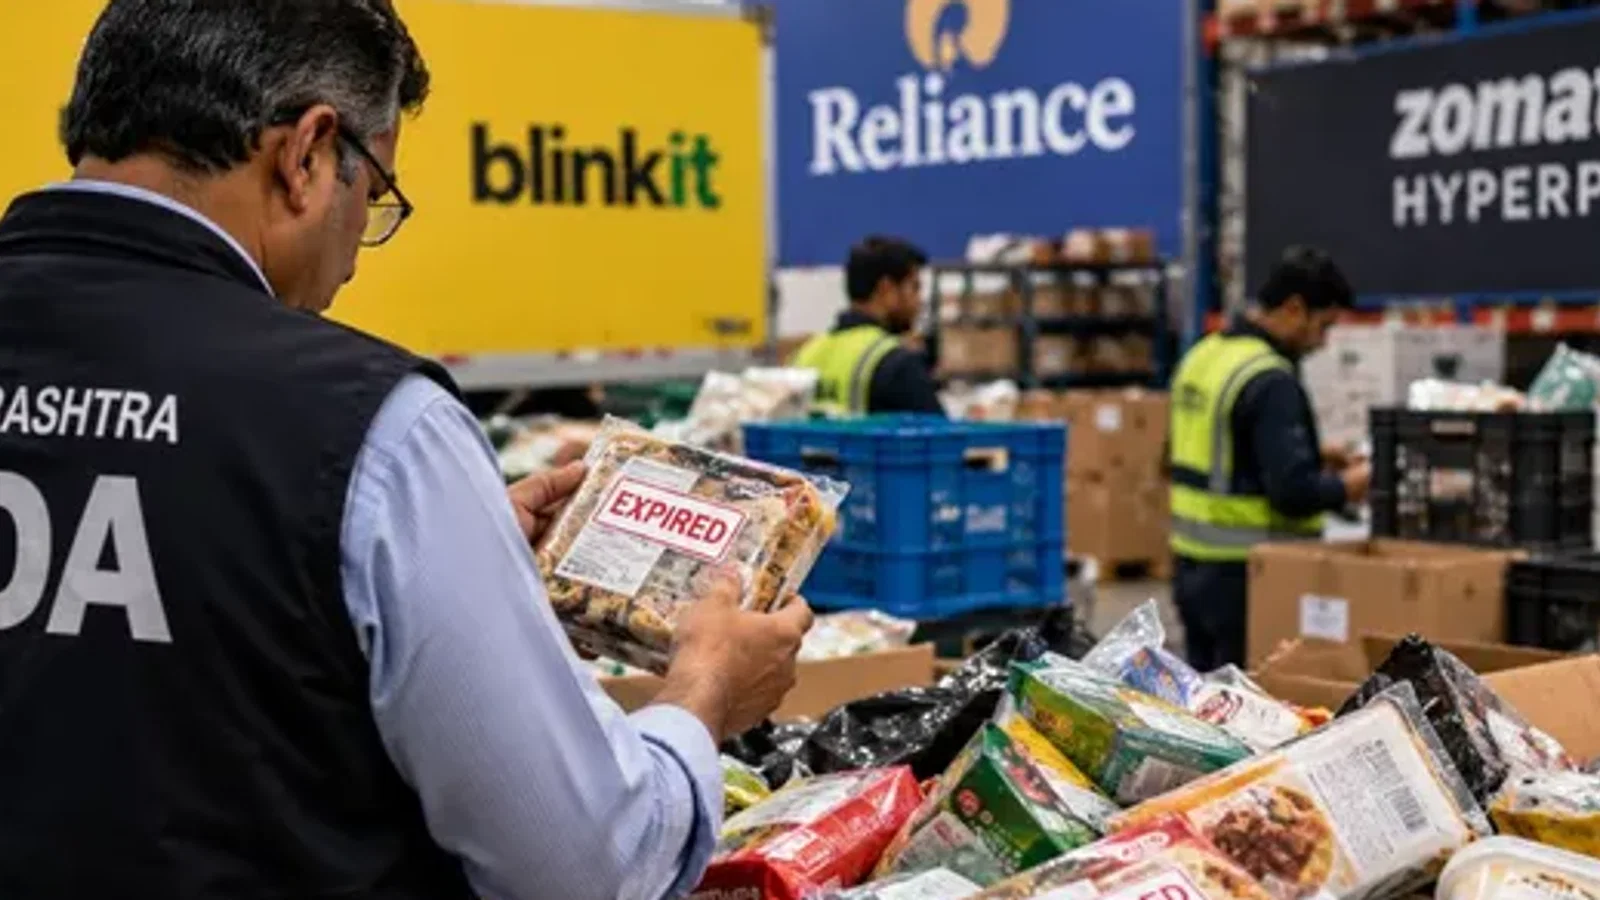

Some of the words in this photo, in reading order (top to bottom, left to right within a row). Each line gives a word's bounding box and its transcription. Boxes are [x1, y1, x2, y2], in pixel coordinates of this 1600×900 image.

[808, 72, 1136, 176] Reliance
[1389, 66, 1600, 159] zoma
[471, 122, 722, 209] blinkit
[1393, 161, 1600, 228] HYPERP
[0, 385, 178, 444] ASHTRA
[609, 490, 728, 545] EXPIRED
